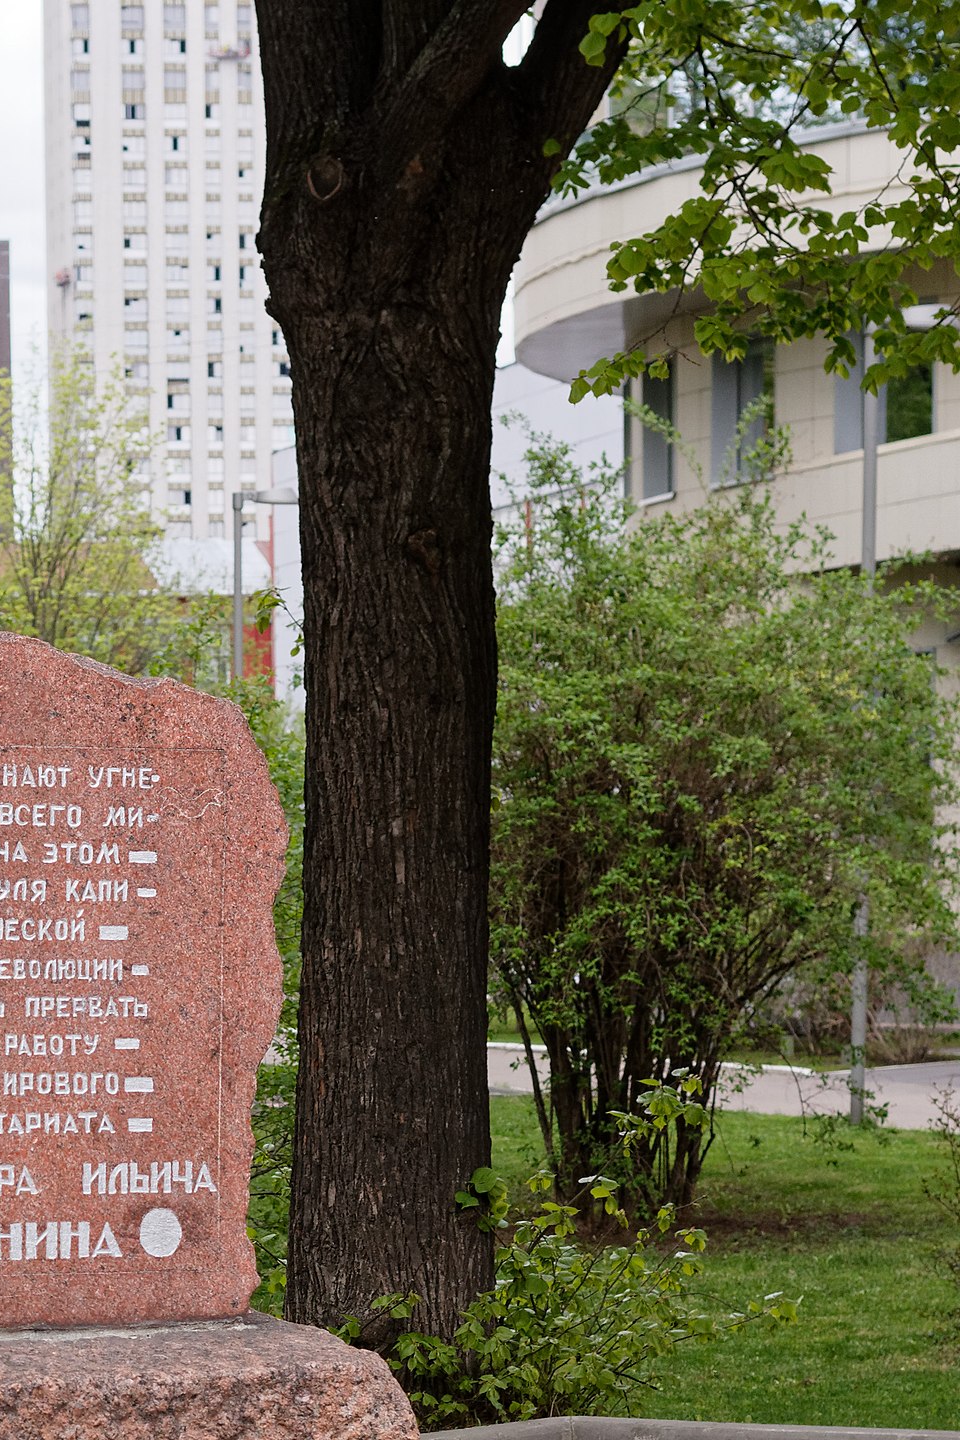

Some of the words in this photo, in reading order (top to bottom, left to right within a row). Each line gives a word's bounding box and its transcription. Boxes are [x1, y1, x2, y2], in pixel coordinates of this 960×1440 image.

[42, 841, 120, 864] ЭТОМ
[25, 996, 149, 1018] ПРЕРВАТЬ
[4, 1034, 100, 1056] РАБОТУ
[82, 1160, 218, 1195] ИЛЬИЧА
